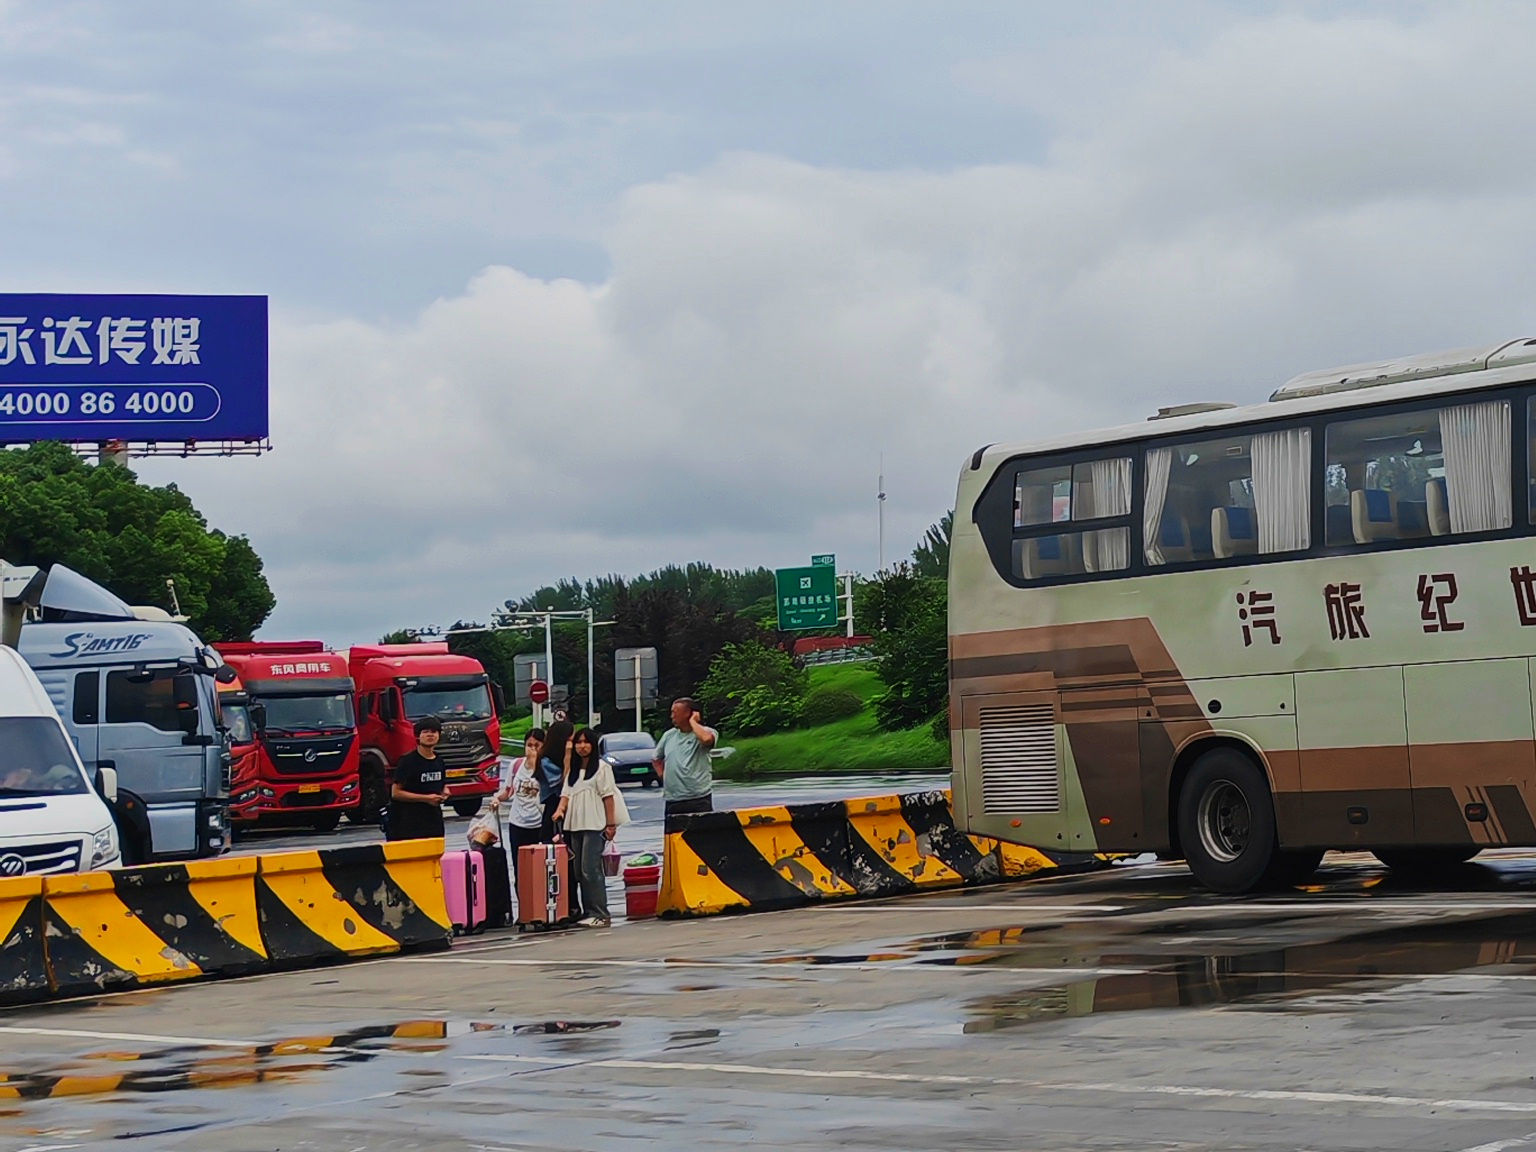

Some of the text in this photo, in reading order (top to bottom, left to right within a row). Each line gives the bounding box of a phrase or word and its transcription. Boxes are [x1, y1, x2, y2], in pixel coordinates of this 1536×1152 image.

[80, 392, 115, 414] 86
[125, 391, 194, 413] 4000
[270, 662, 331, 676] 东风商用车
